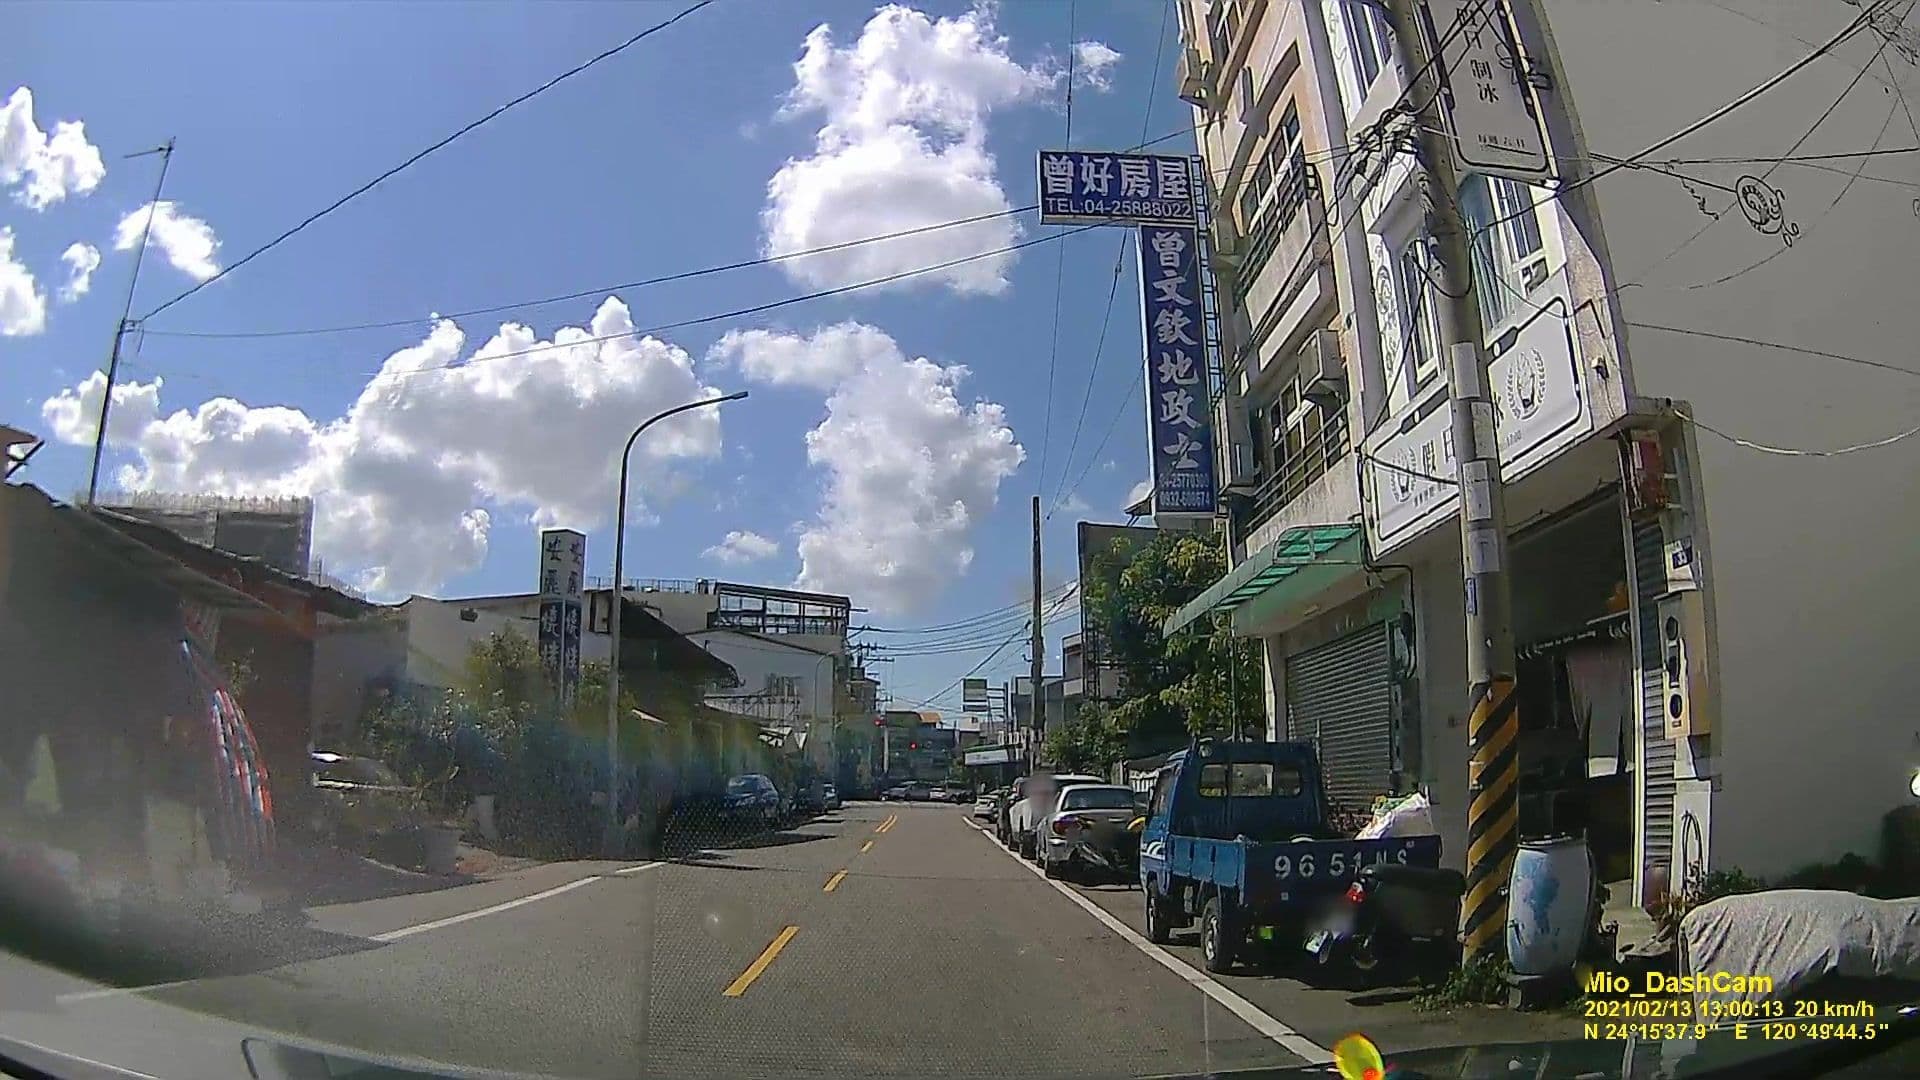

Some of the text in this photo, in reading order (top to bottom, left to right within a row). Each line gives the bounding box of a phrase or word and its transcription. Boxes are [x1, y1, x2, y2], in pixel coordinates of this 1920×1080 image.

[1043, 154, 1190, 200] 曾好房屋
[1151, 231, 1205, 469] 曾文欽地政士
